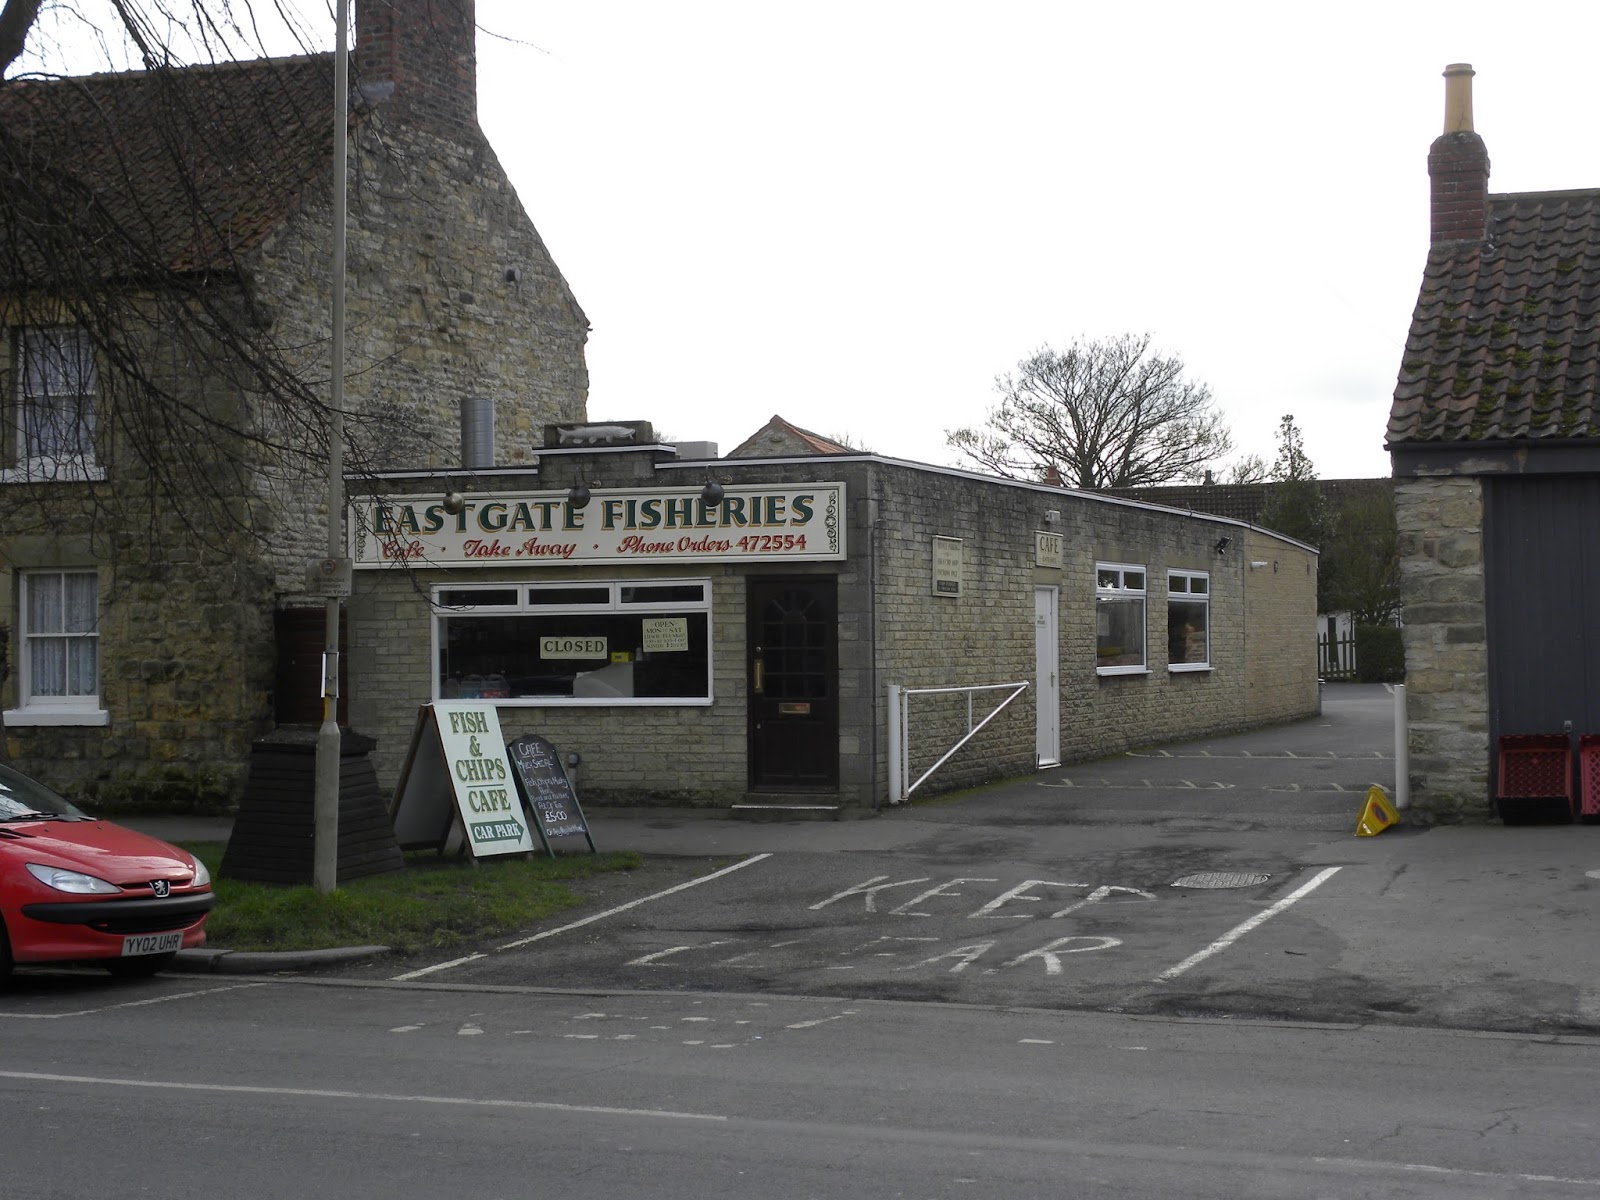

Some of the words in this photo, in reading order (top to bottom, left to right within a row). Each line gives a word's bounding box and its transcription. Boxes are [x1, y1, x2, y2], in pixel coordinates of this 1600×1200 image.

[373, 501, 585, 536] EASTGATE
[601, 495, 815, 530] FISHERIES
[463, 539, 511, 557] Take
[516, 537, 577, 559] Away
[617, 535, 674, 553] Phone
[736, 534, 807, 552] 472554
[1040, 536, 1059, 554] CAFE
[543, 640, 605, 653] CLOSED
[448, 711, 490, 734] FISH
[468, 735, 483, 758] &
[518, 742, 544, 757] CAFE
[455, 757, 506, 782] CHIPS
[467, 788, 512, 813] CAFE
[474, 824, 495, 840] CAR
[494, 822, 522, 838] PARK
[808, 875, 1158, 919] KEEP
[128, 937, 157, 952] YY02
[158, 934, 180, 950] UHR
